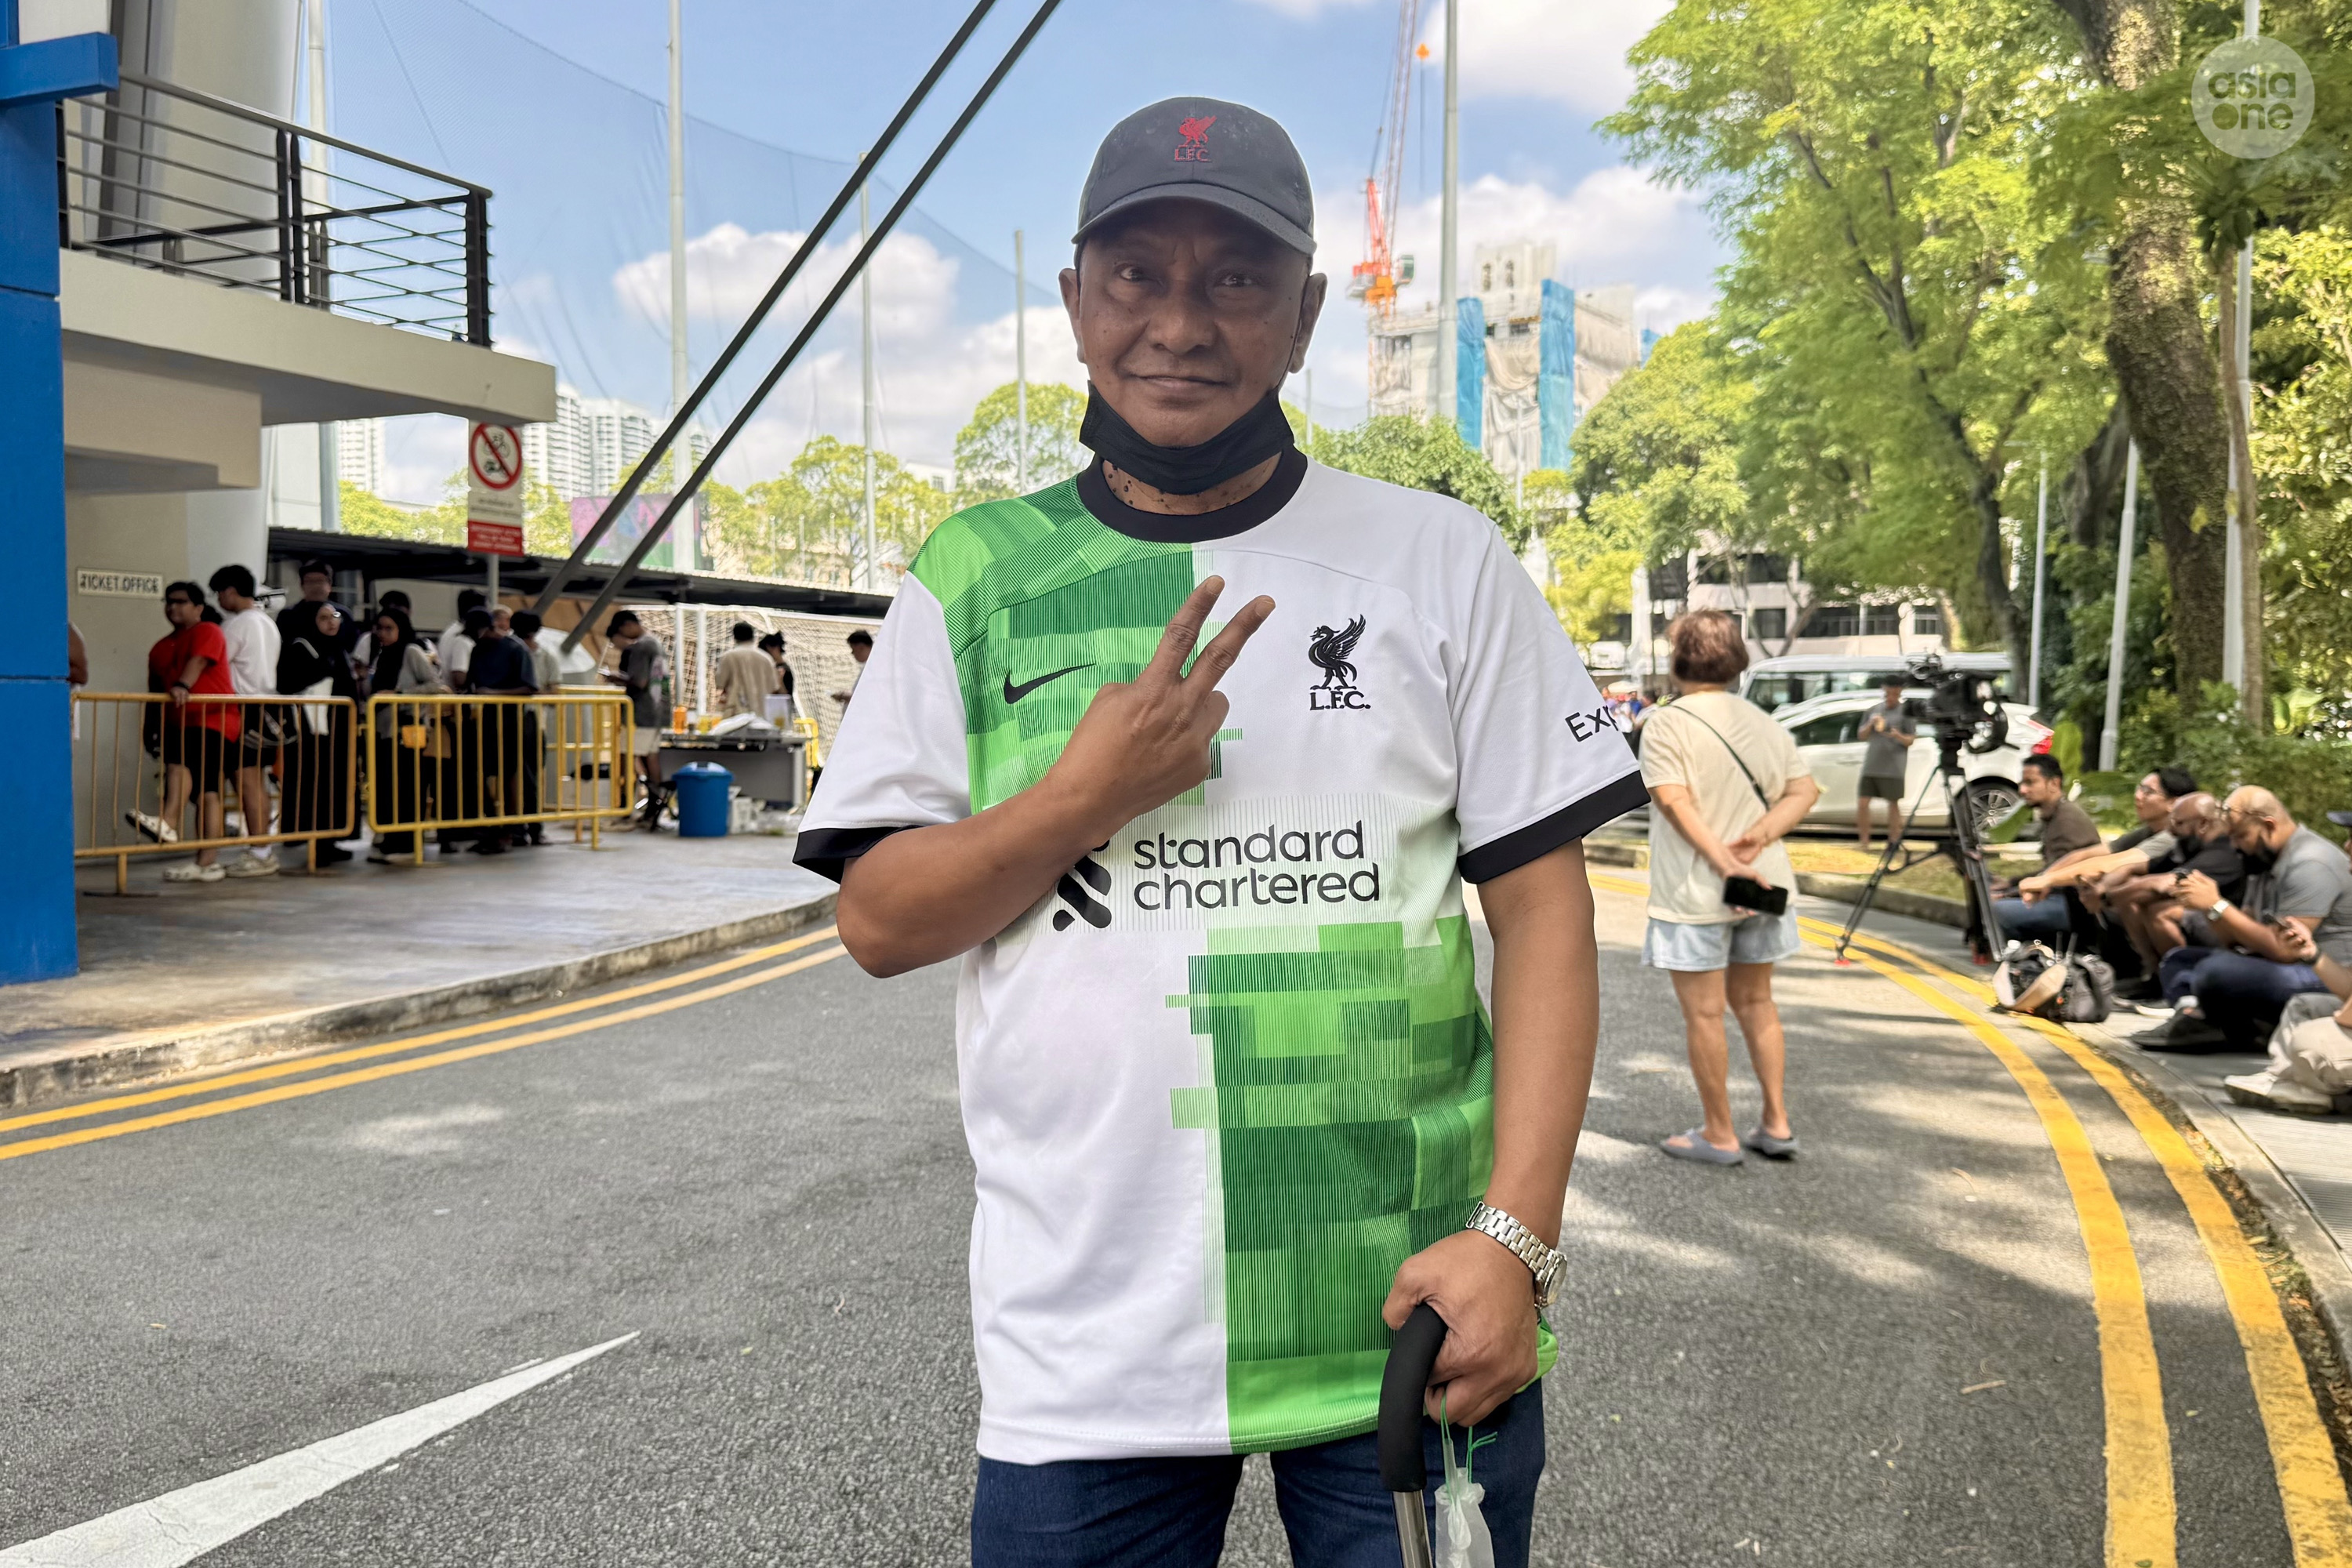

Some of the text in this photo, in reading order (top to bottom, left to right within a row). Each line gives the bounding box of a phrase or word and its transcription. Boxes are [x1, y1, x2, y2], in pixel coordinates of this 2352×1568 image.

[80, 573, 158, 593] TICKET OFFICE
[1134, 820, 1364, 869] standard
[1134, 862, 1380, 911] chartered
